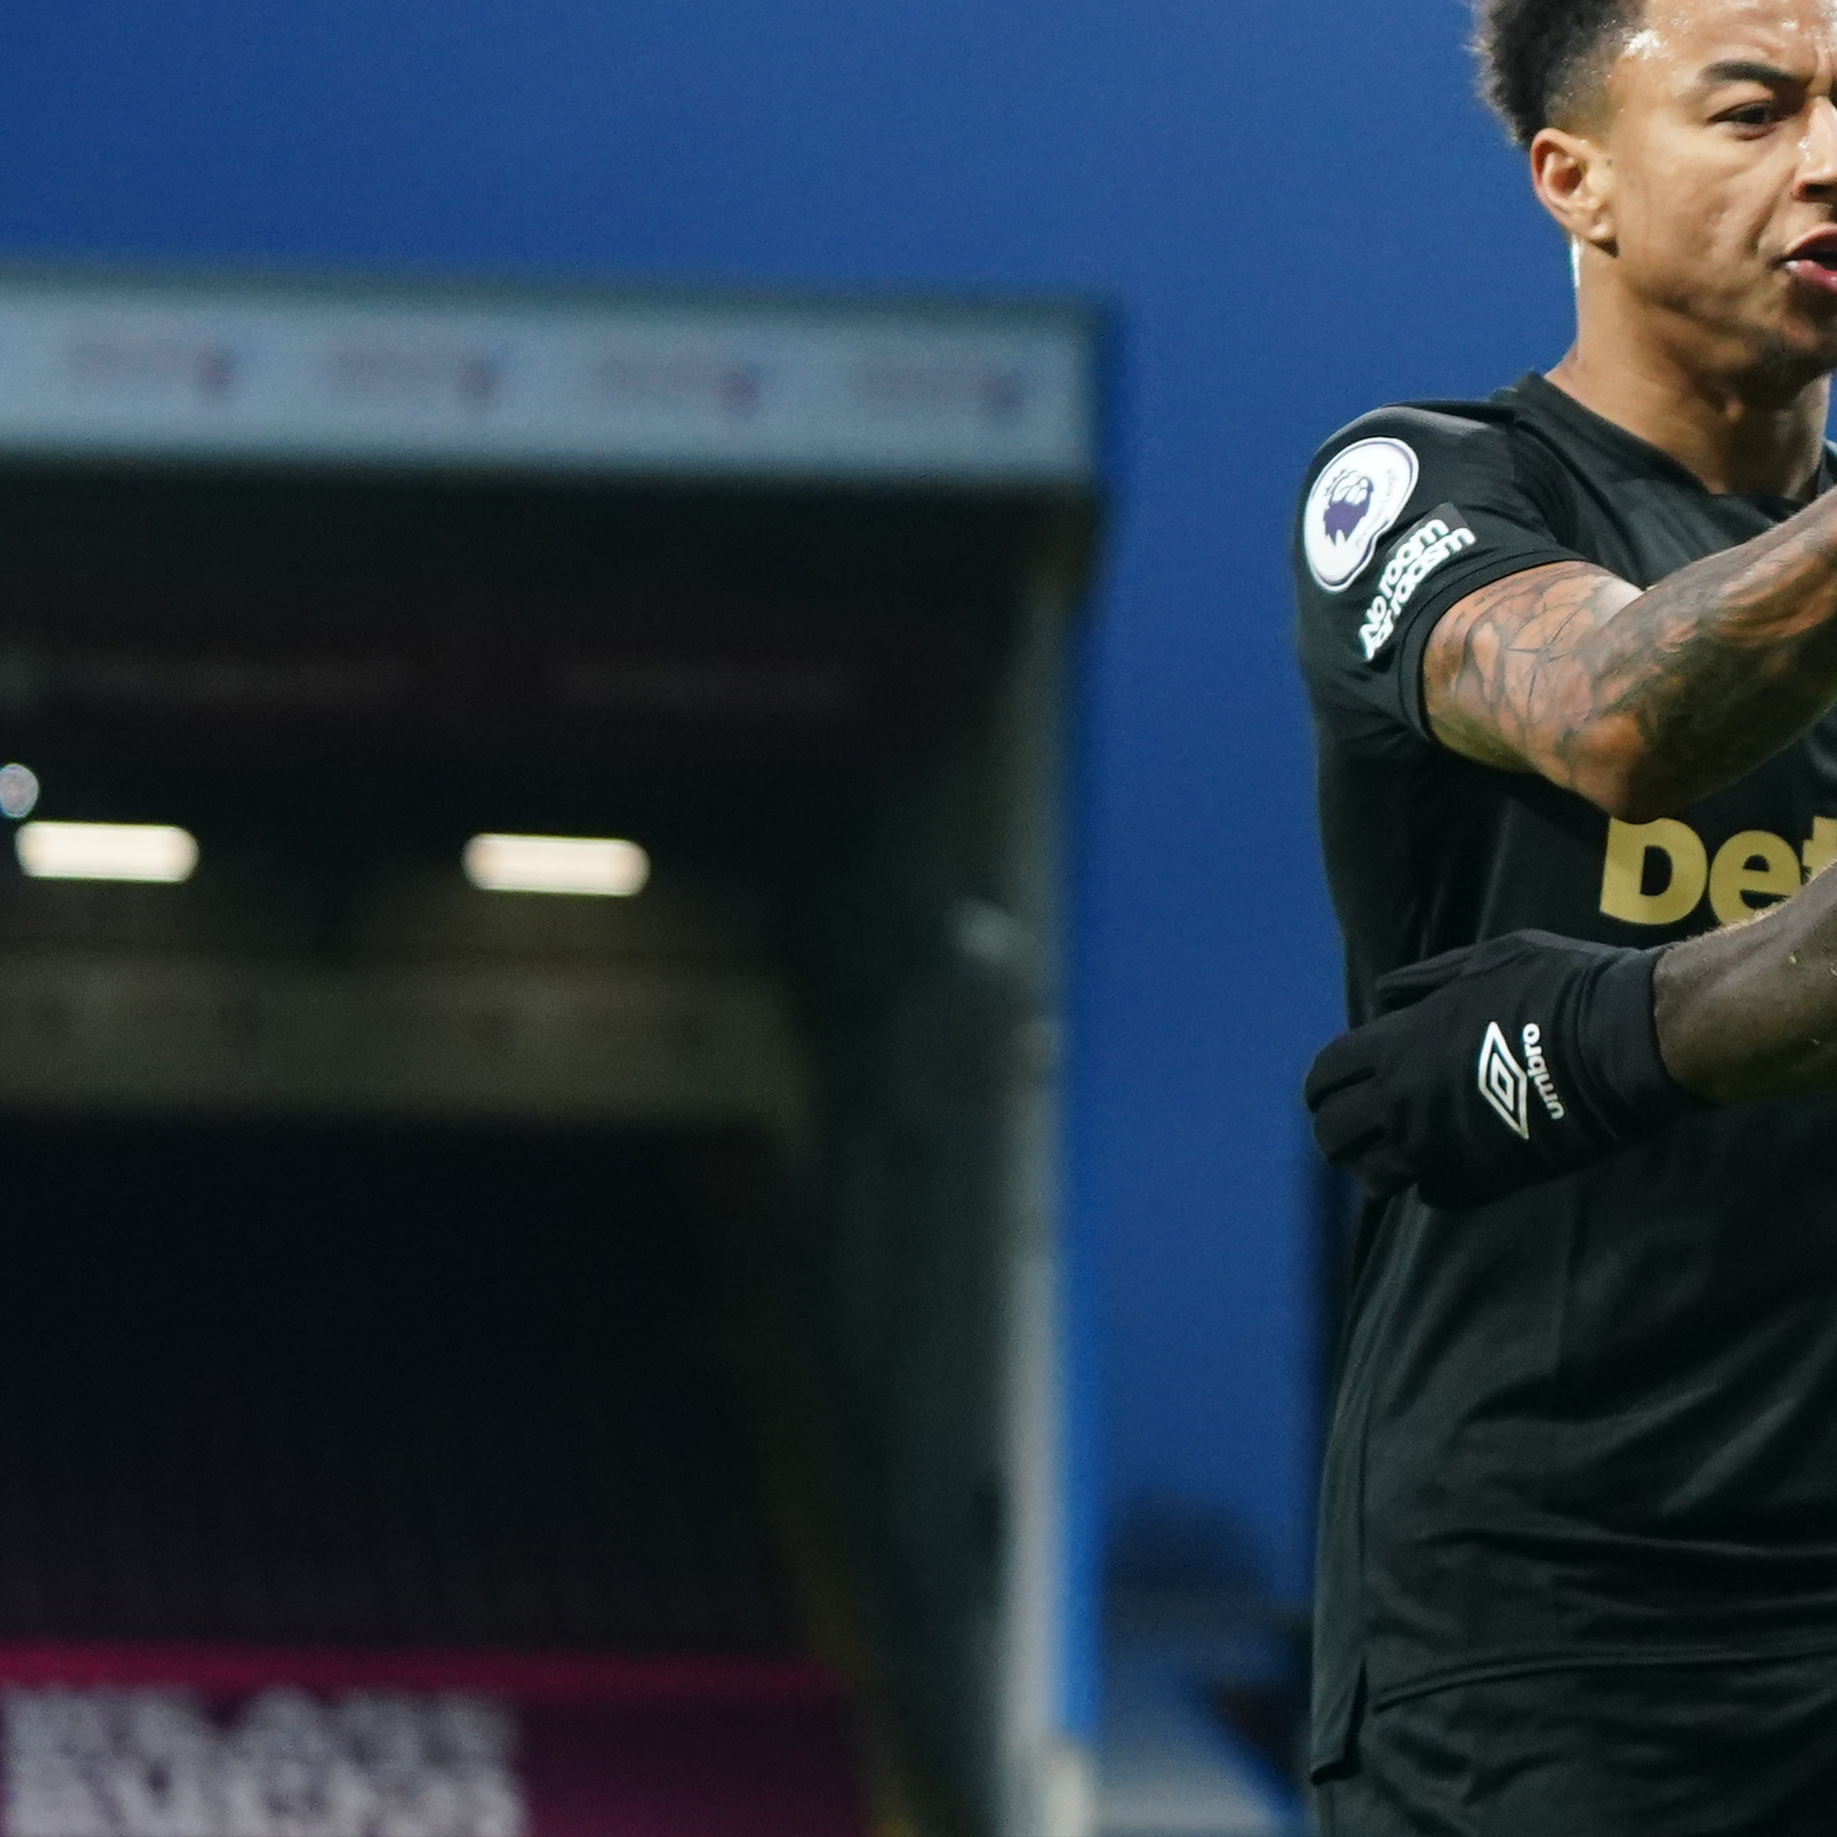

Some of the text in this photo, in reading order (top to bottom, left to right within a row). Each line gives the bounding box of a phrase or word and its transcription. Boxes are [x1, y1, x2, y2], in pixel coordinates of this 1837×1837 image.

[1358, 595, 1387, 660] No
[1379, 518, 1449, 600] room
[1390, 527, 1477, 616] racism
[1522, 1022, 1564, 1120] umbro
